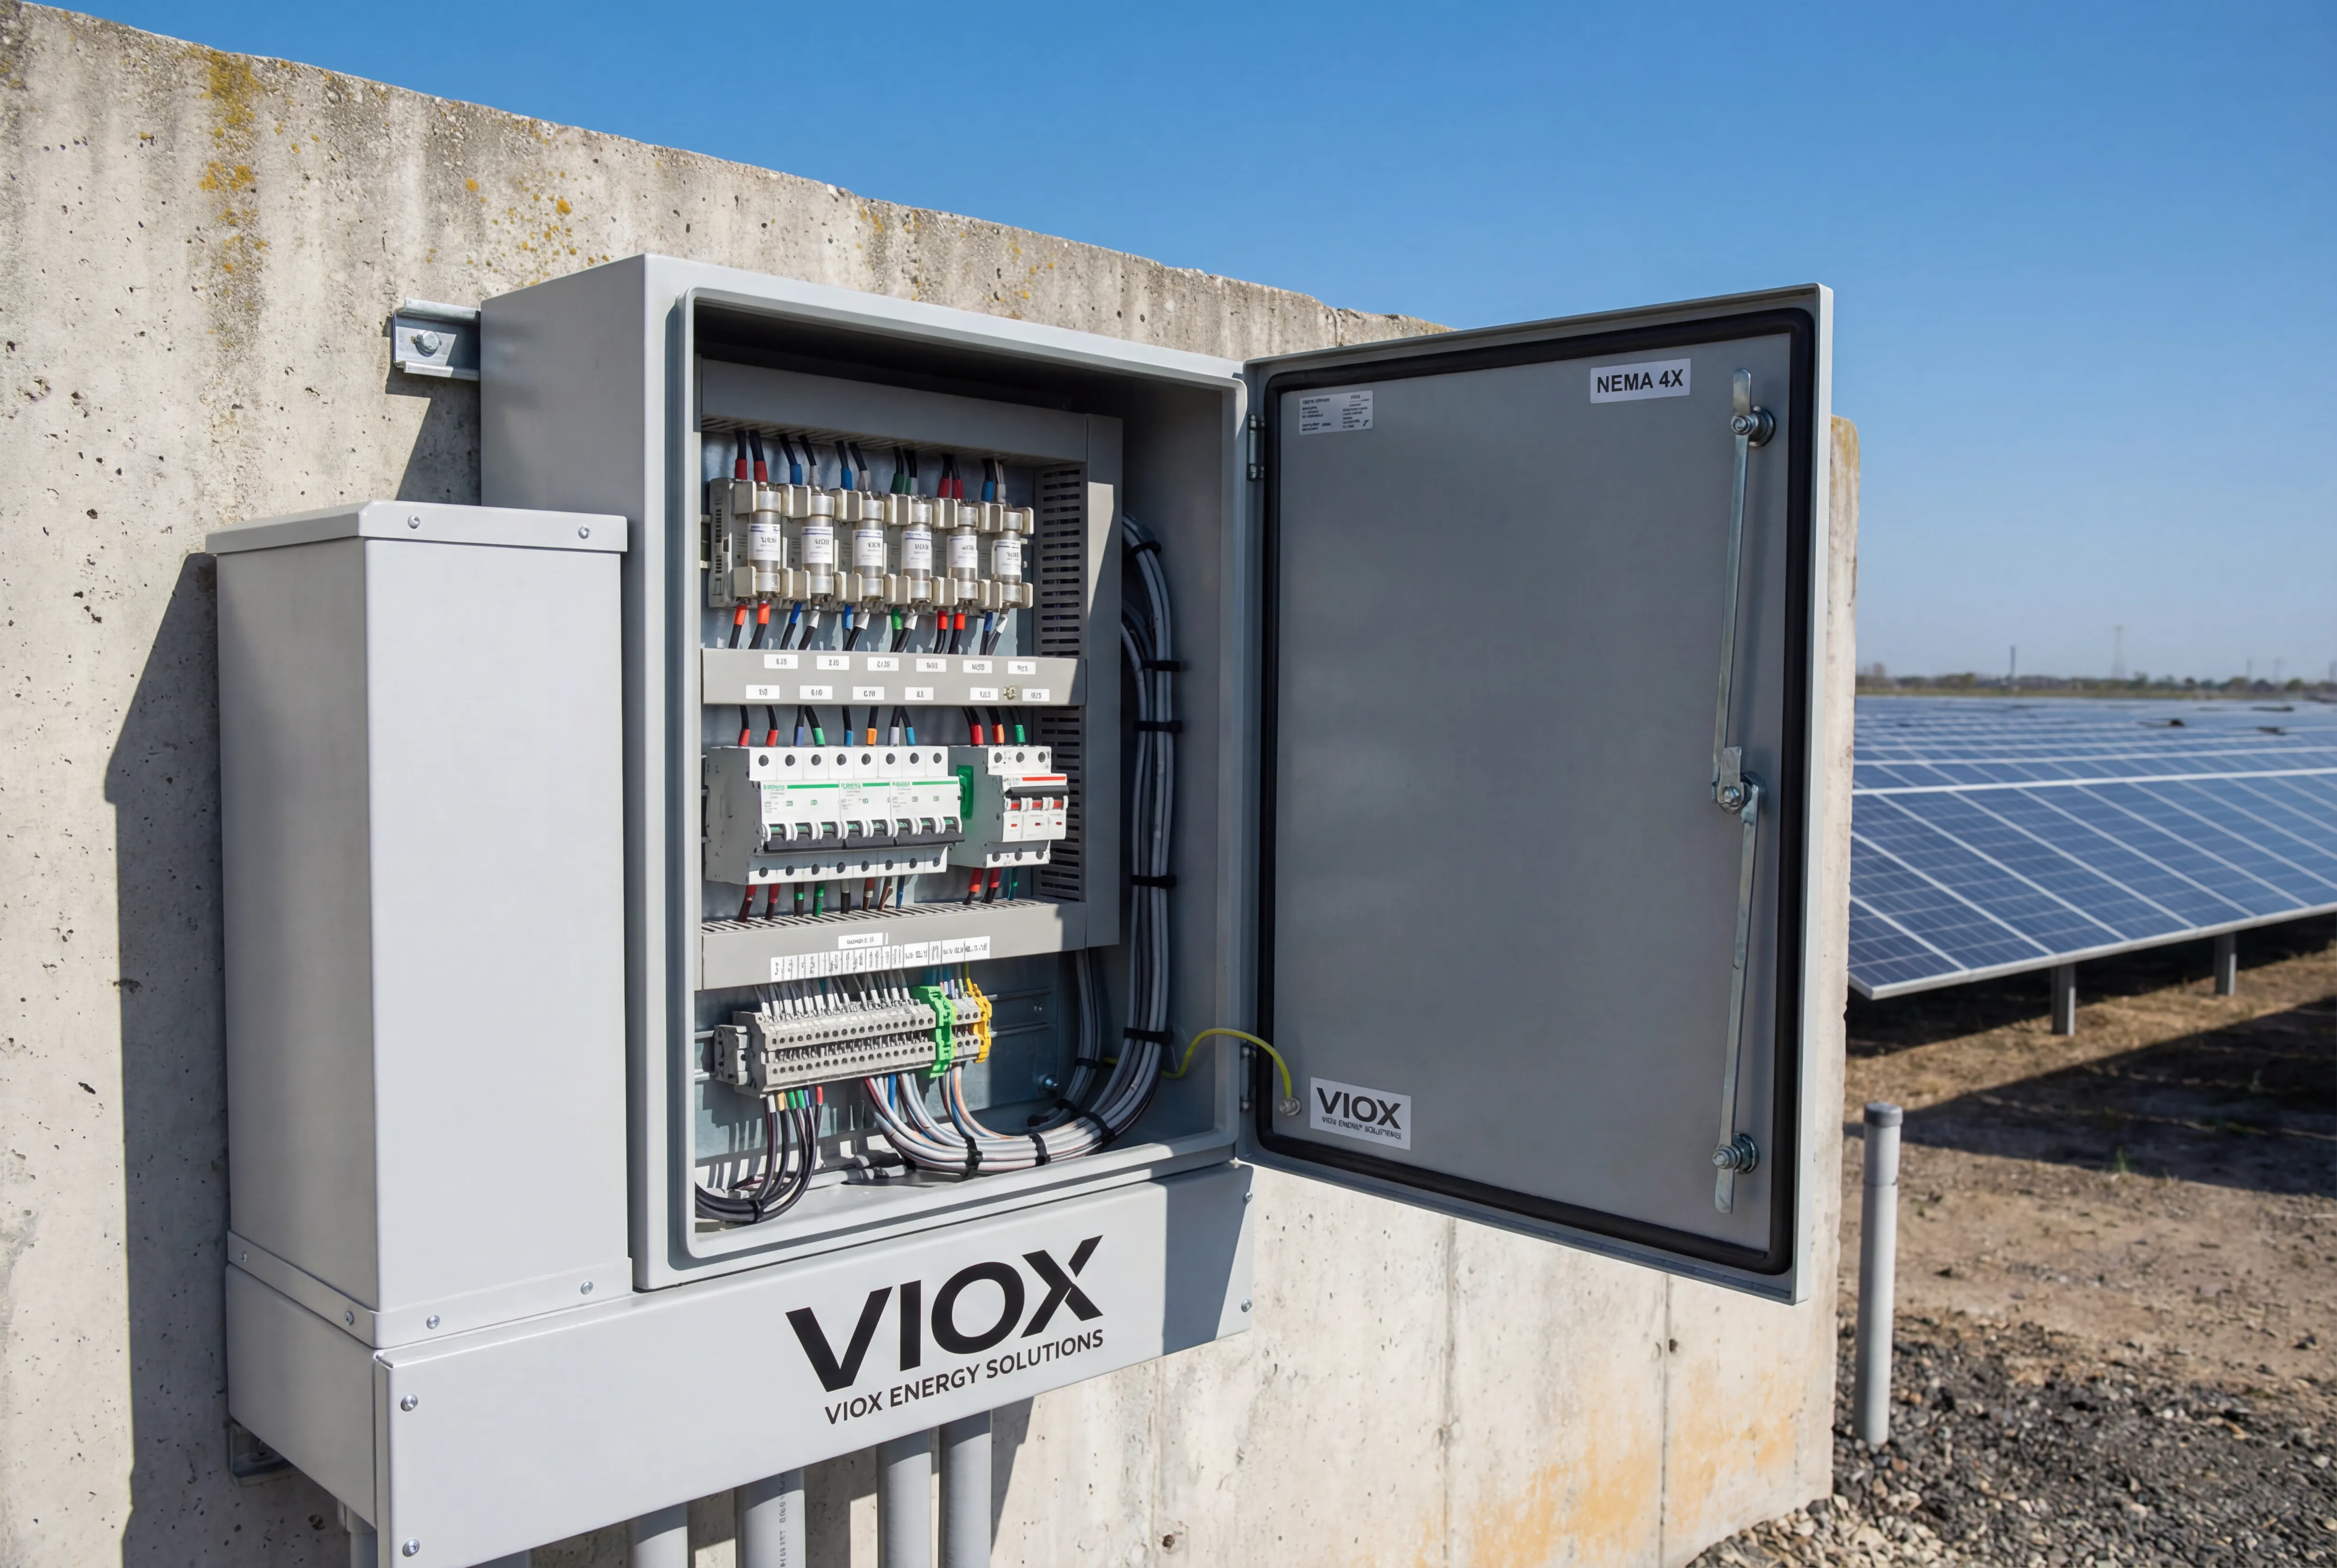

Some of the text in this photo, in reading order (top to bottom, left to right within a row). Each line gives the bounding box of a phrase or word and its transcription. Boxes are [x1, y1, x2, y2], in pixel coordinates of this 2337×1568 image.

[1597, 369, 1683, 393] NEMA 4X
[1316, 1087, 1401, 1129] VIOX
[785, 1235, 1104, 1392] VIOX
[825, 1329, 1104, 1425] VIOX ENERGY SOLUTIONS
